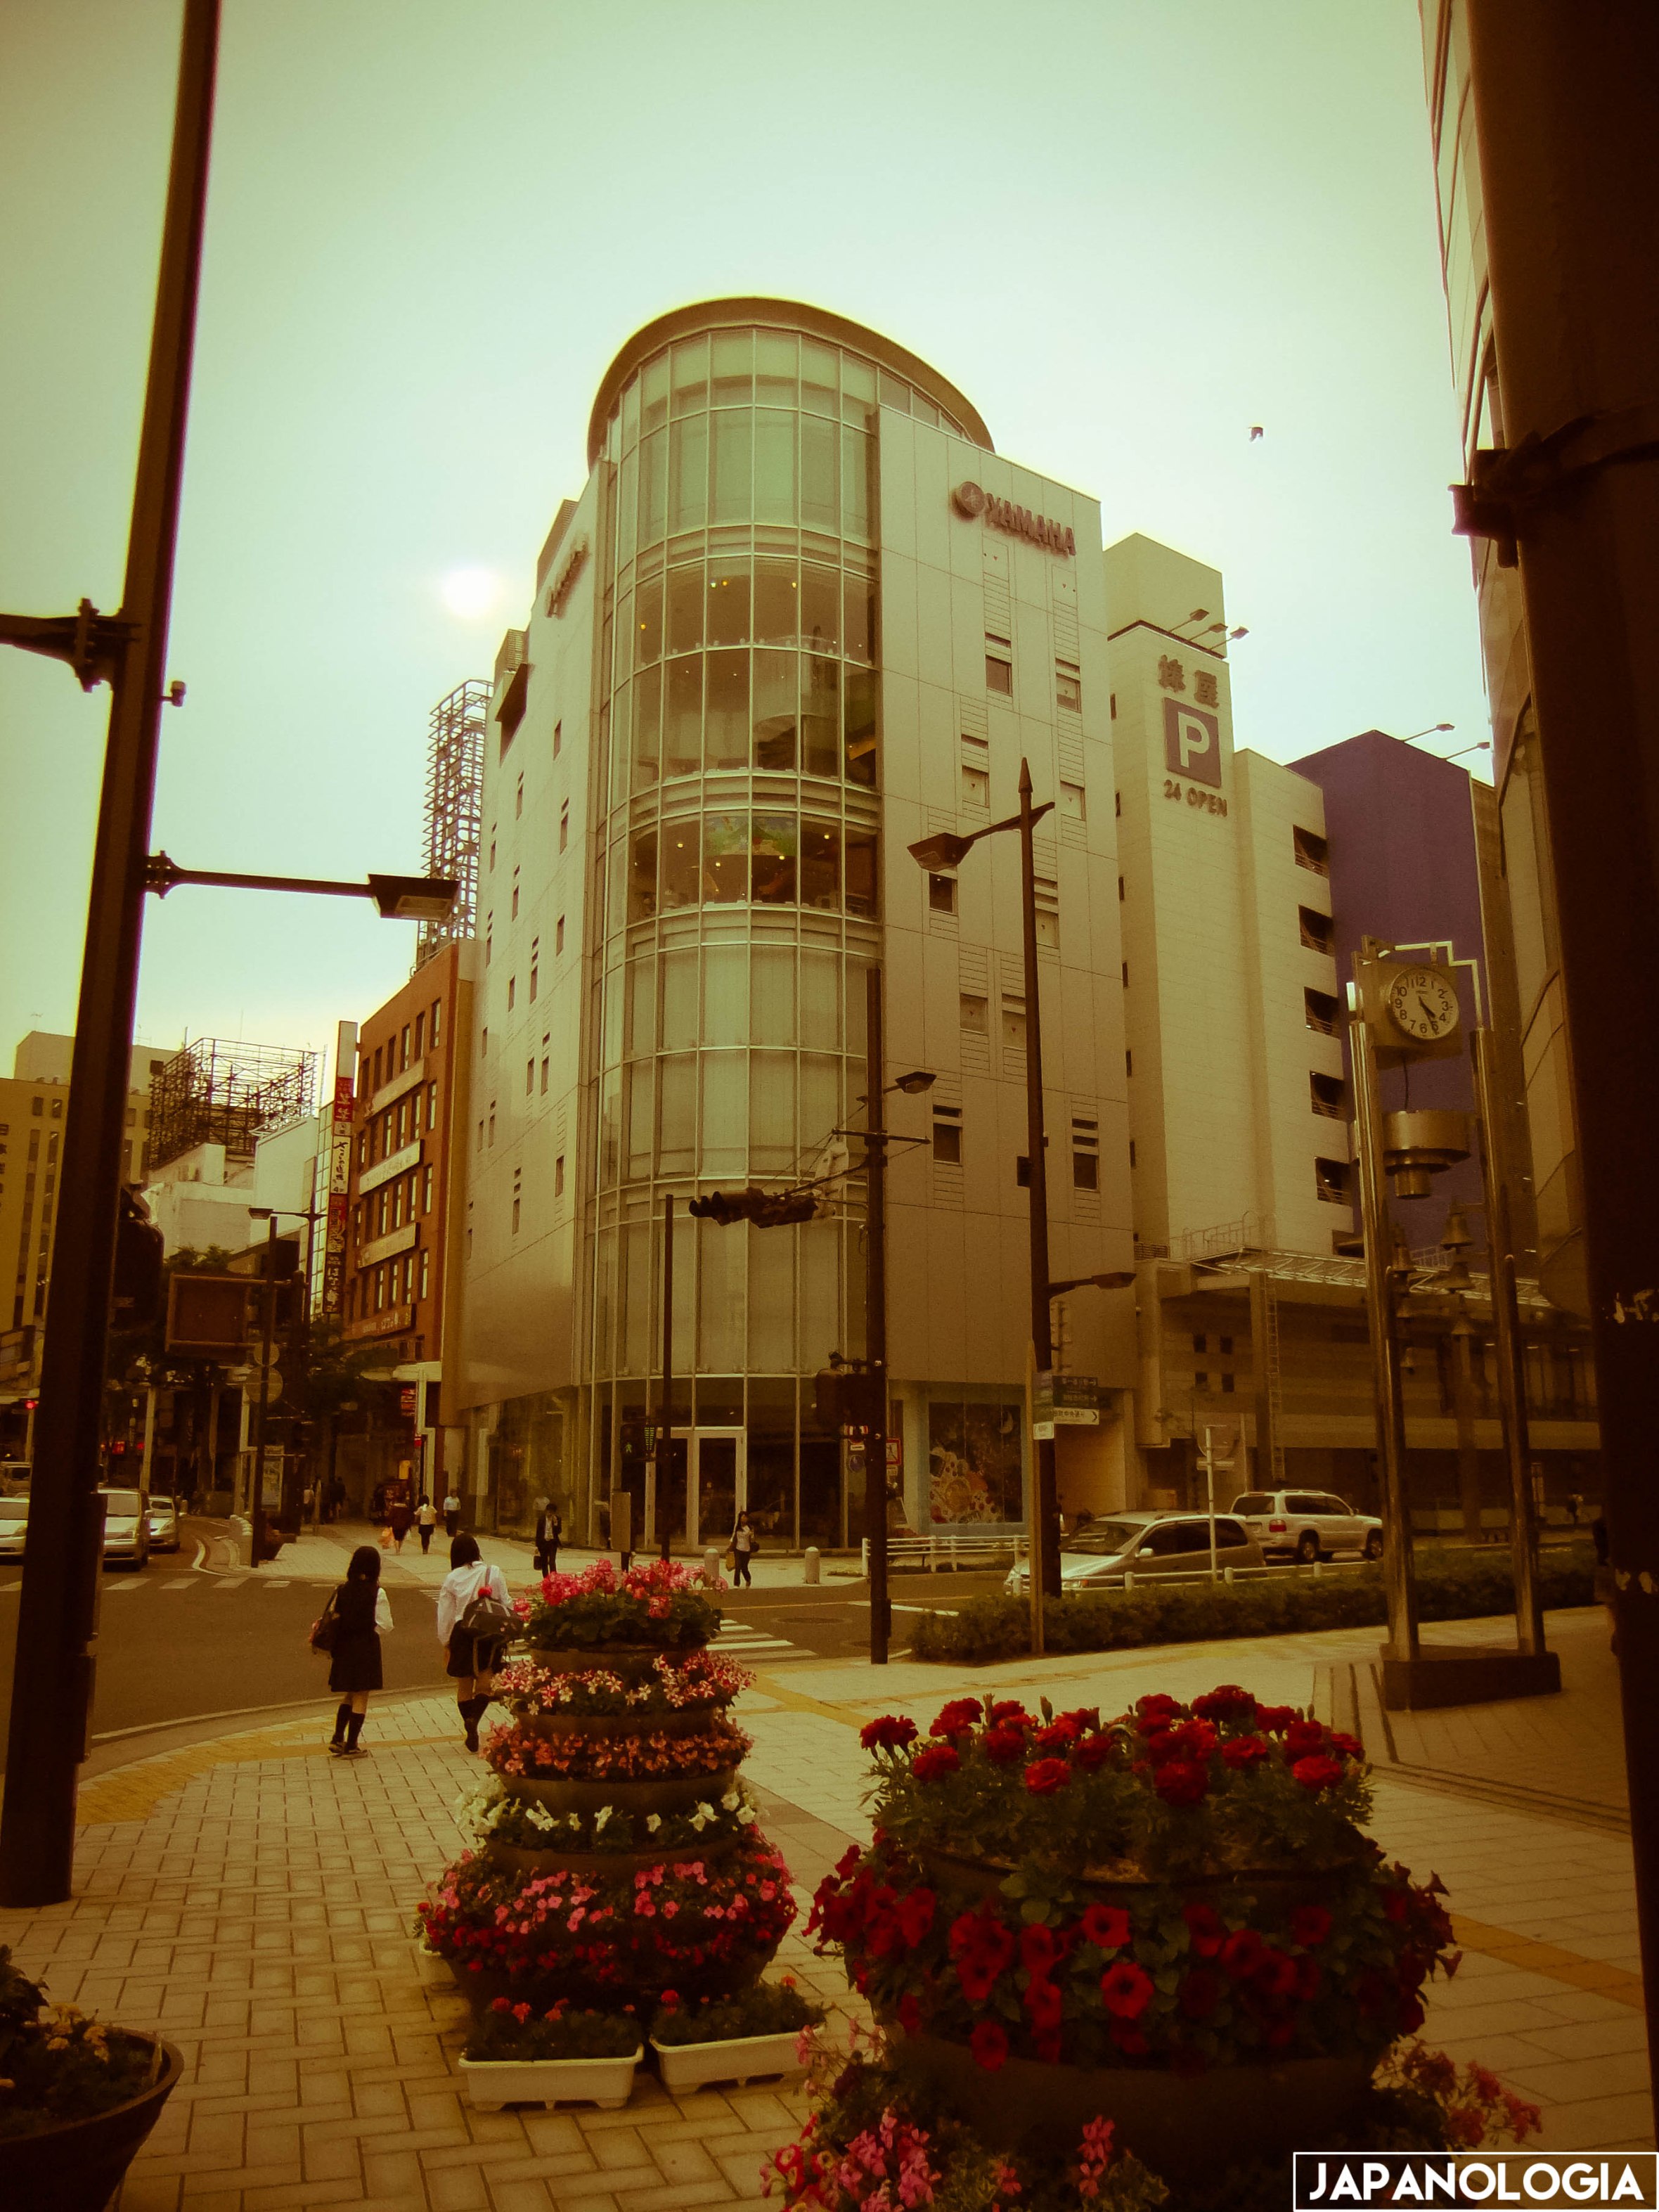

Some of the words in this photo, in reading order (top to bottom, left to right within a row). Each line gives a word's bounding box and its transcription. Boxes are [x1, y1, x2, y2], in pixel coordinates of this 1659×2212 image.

[985, 492, 1077, 558] YAMAHA
[1177, 712, 1210, 768] P
[1164, 779, 1182, 801] 24
[1187, 787, 1228, 818] OPEN
[1406, 978, 1414, 989] 11
[1416, 975, 1426, 987] 12
[1395, 986, 1407, 997] 10
[1438, 989, 1446, 998] 2
[1395, 998, 1402, 1008] 9
[1442, 1001, 1449, 1012] 3
[1400, 1010, 1407, 1020] 8
[1439, 1012, 1447, 1022] 4
[1409, 1020, 1416, 1030] 7
[1420, 1023, 1428, 1034] 6
